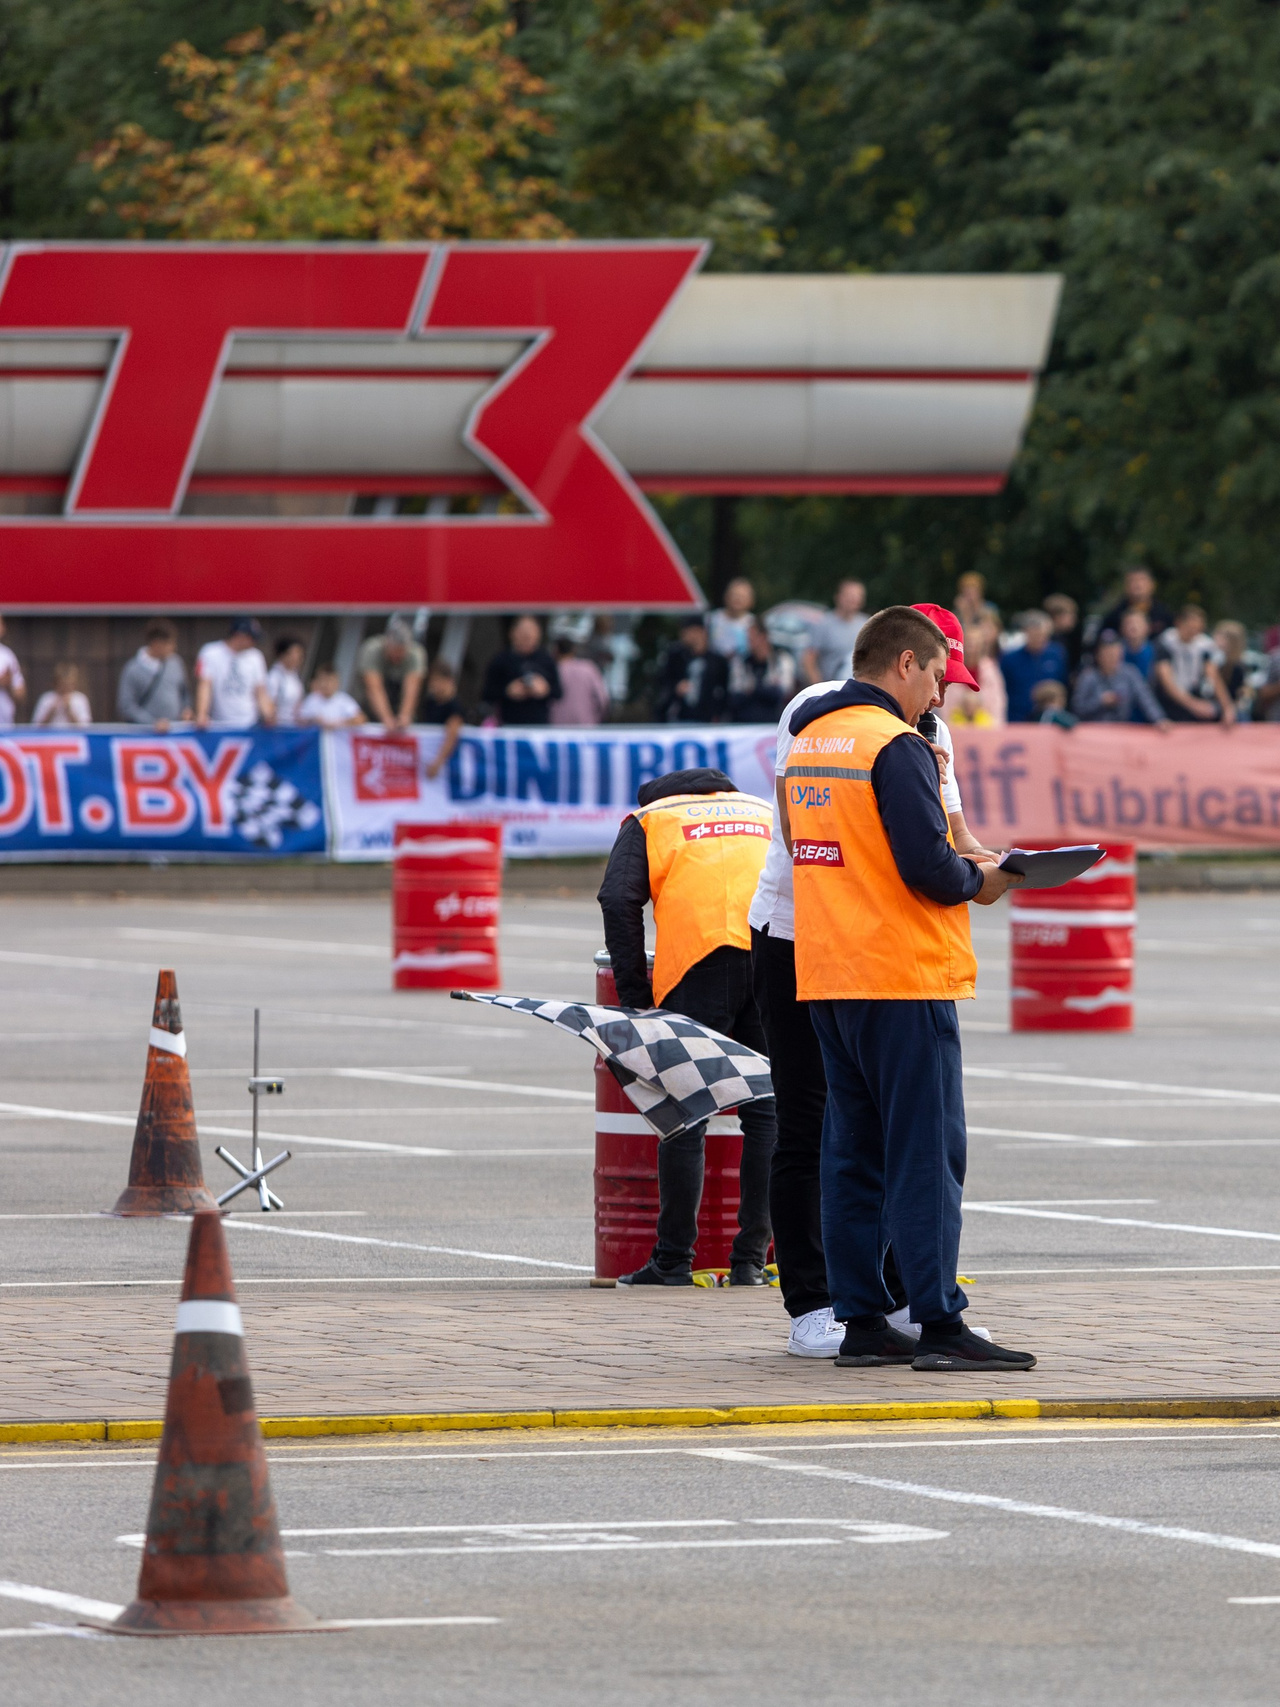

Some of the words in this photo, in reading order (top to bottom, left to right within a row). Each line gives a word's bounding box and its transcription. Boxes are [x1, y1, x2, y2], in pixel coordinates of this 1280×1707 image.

[793, 737, 856, 754] BELSHINA
[790, 785, 831, 810] СУДЬЯ
[686, 805, 761, 818] СУДЬЯ
[713, 823, 766, 836] CEPSA
[799, 845, 840, 861] CEPSA
